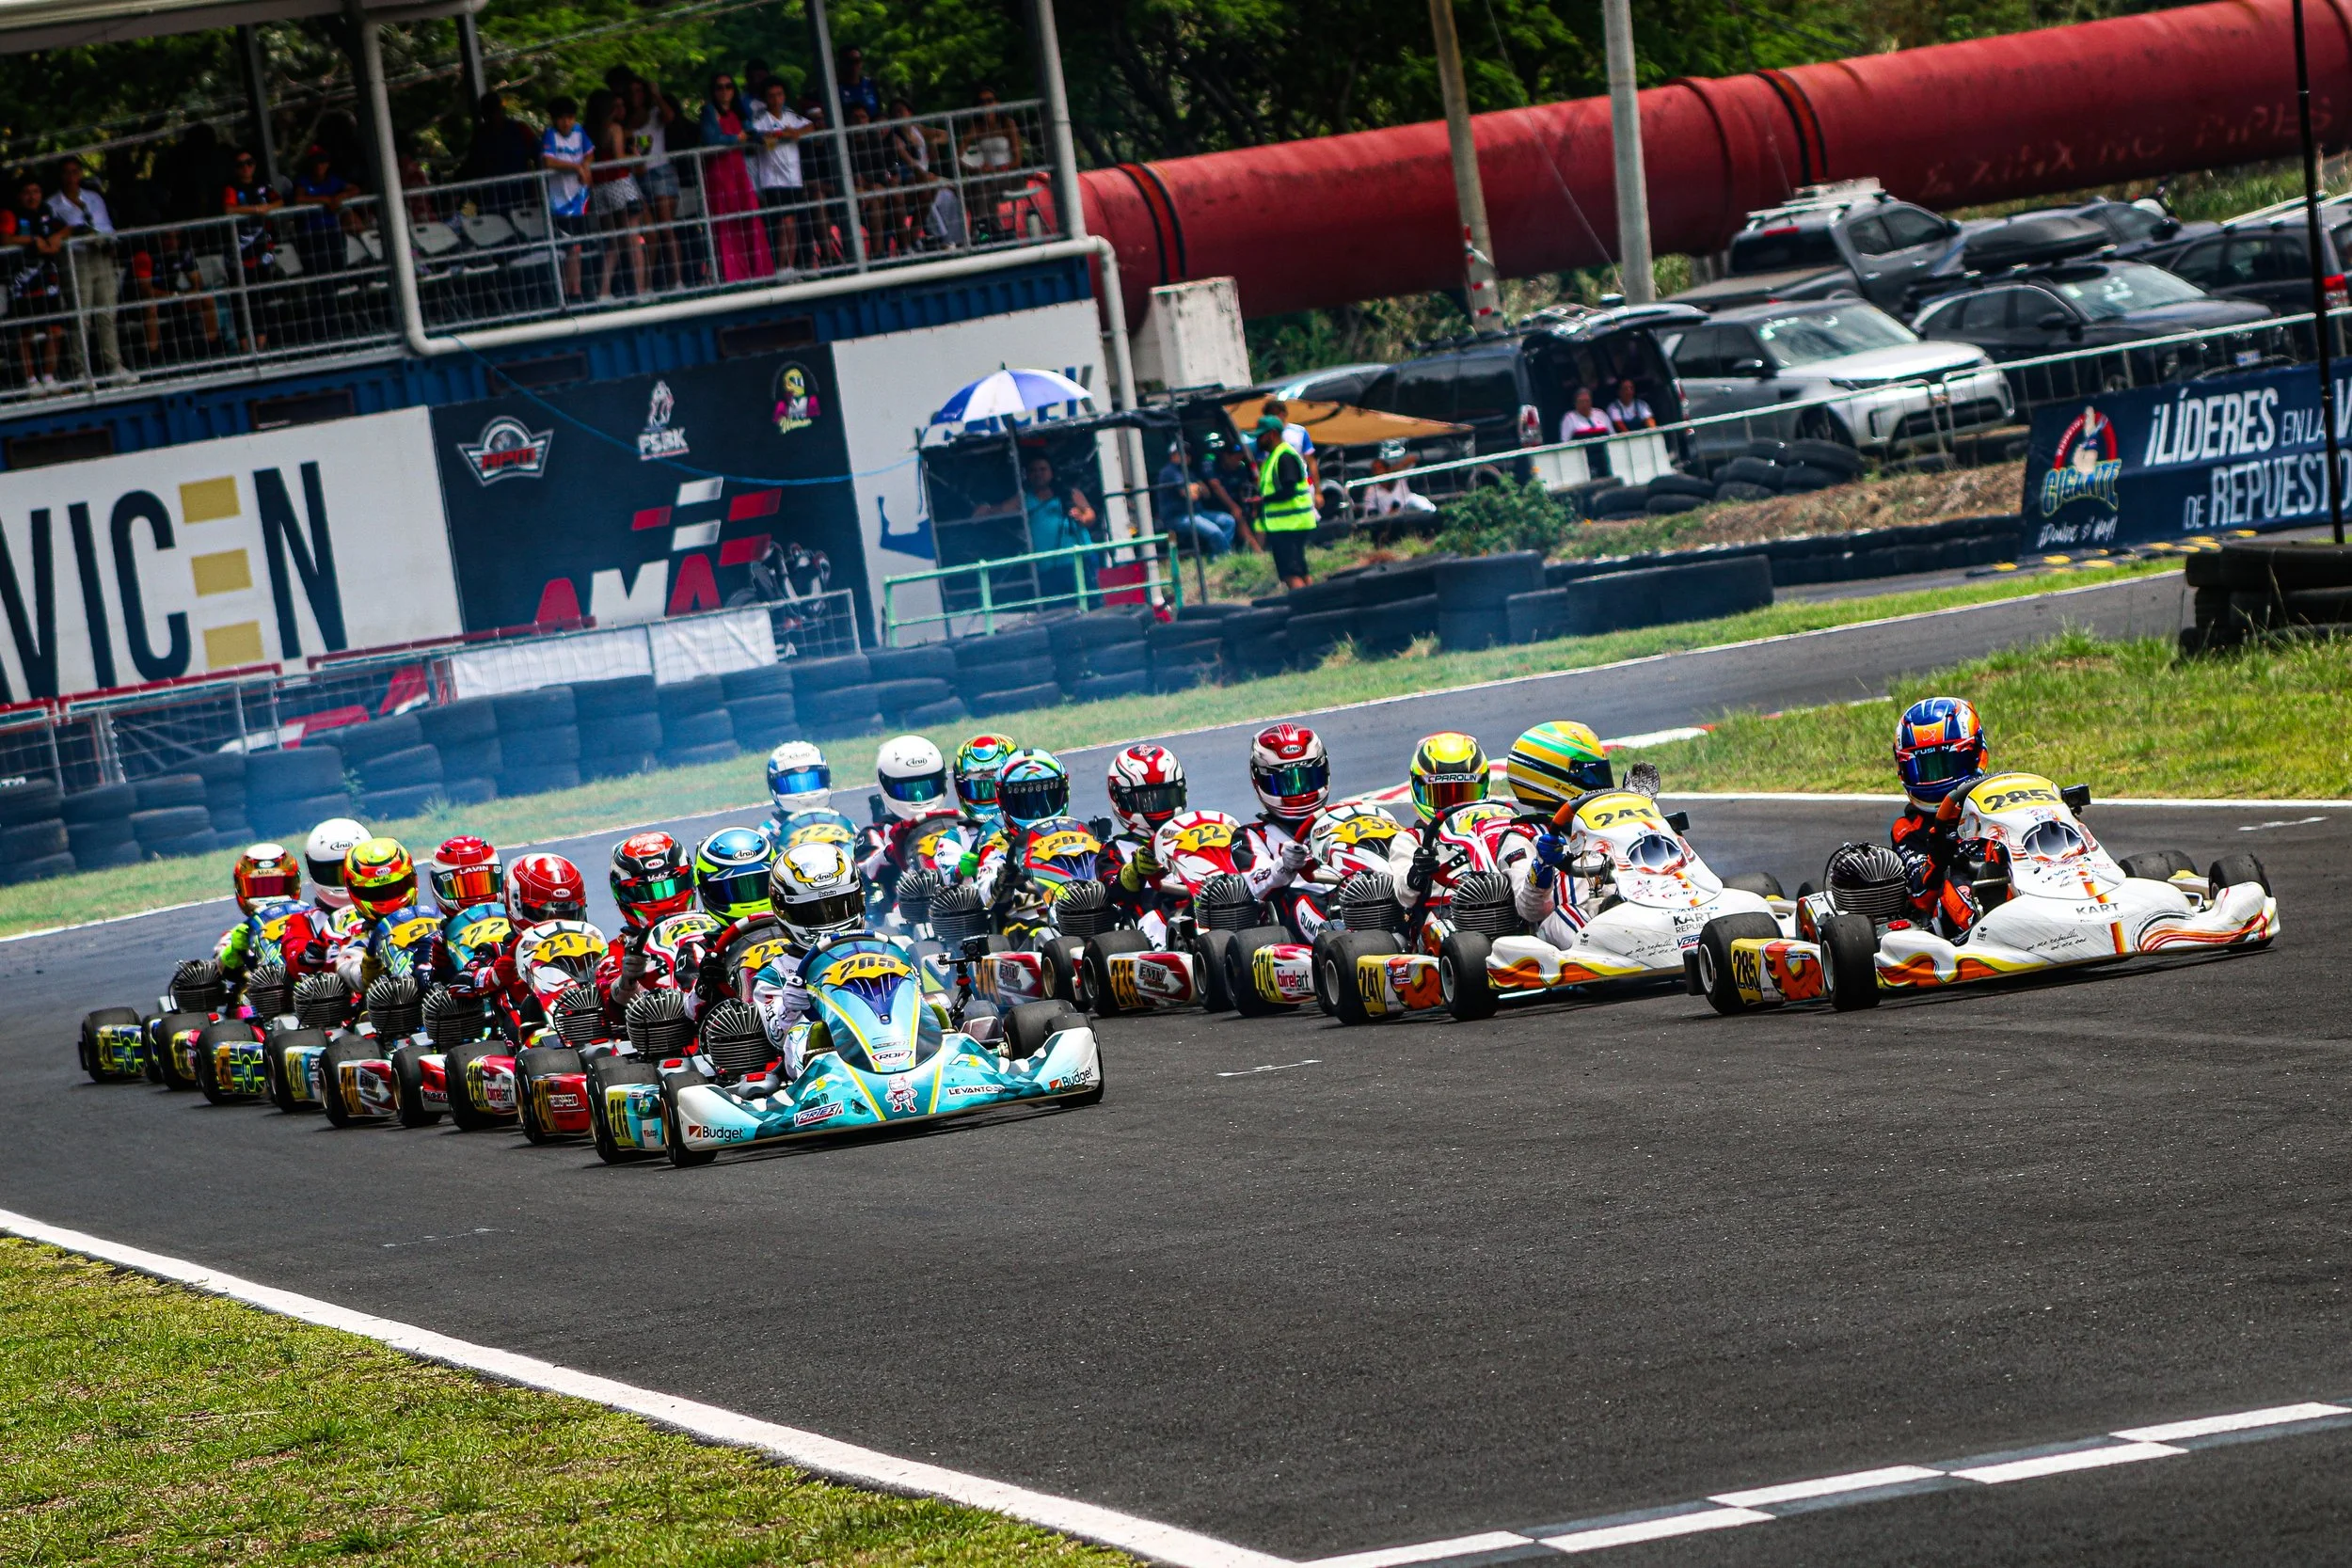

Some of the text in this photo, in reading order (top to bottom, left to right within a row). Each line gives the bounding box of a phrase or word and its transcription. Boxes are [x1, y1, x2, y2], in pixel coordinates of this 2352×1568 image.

[2144, 387, 2278, 467] ¡LÍDERES
[638, 426, 688, 452] FSBK
[2184, 494, 2206, 531] DE
[1983, 789, 2058, 811] 285
[1594, 808, 1654, 826] 241
[734, 849, 754, 859] Arai
[459, 864, 489, 875] LAVIN
[1673, 912, 1712, 926] KART
[2075, 902, 2120, 915] KART
[541, 935, 594, 958] 217
[840, 956, 897, 979] 205
[1733, 949, 1761, 990] 285
[1277, 970, 1309, 988] birelart
[1359, 966, 1383, 1004] 241
[1062, 1066, 1093, 1088] Budget
[796, 1103, 838, 1123] VORTEX
[702, 1126, 744, 1142] Budget
